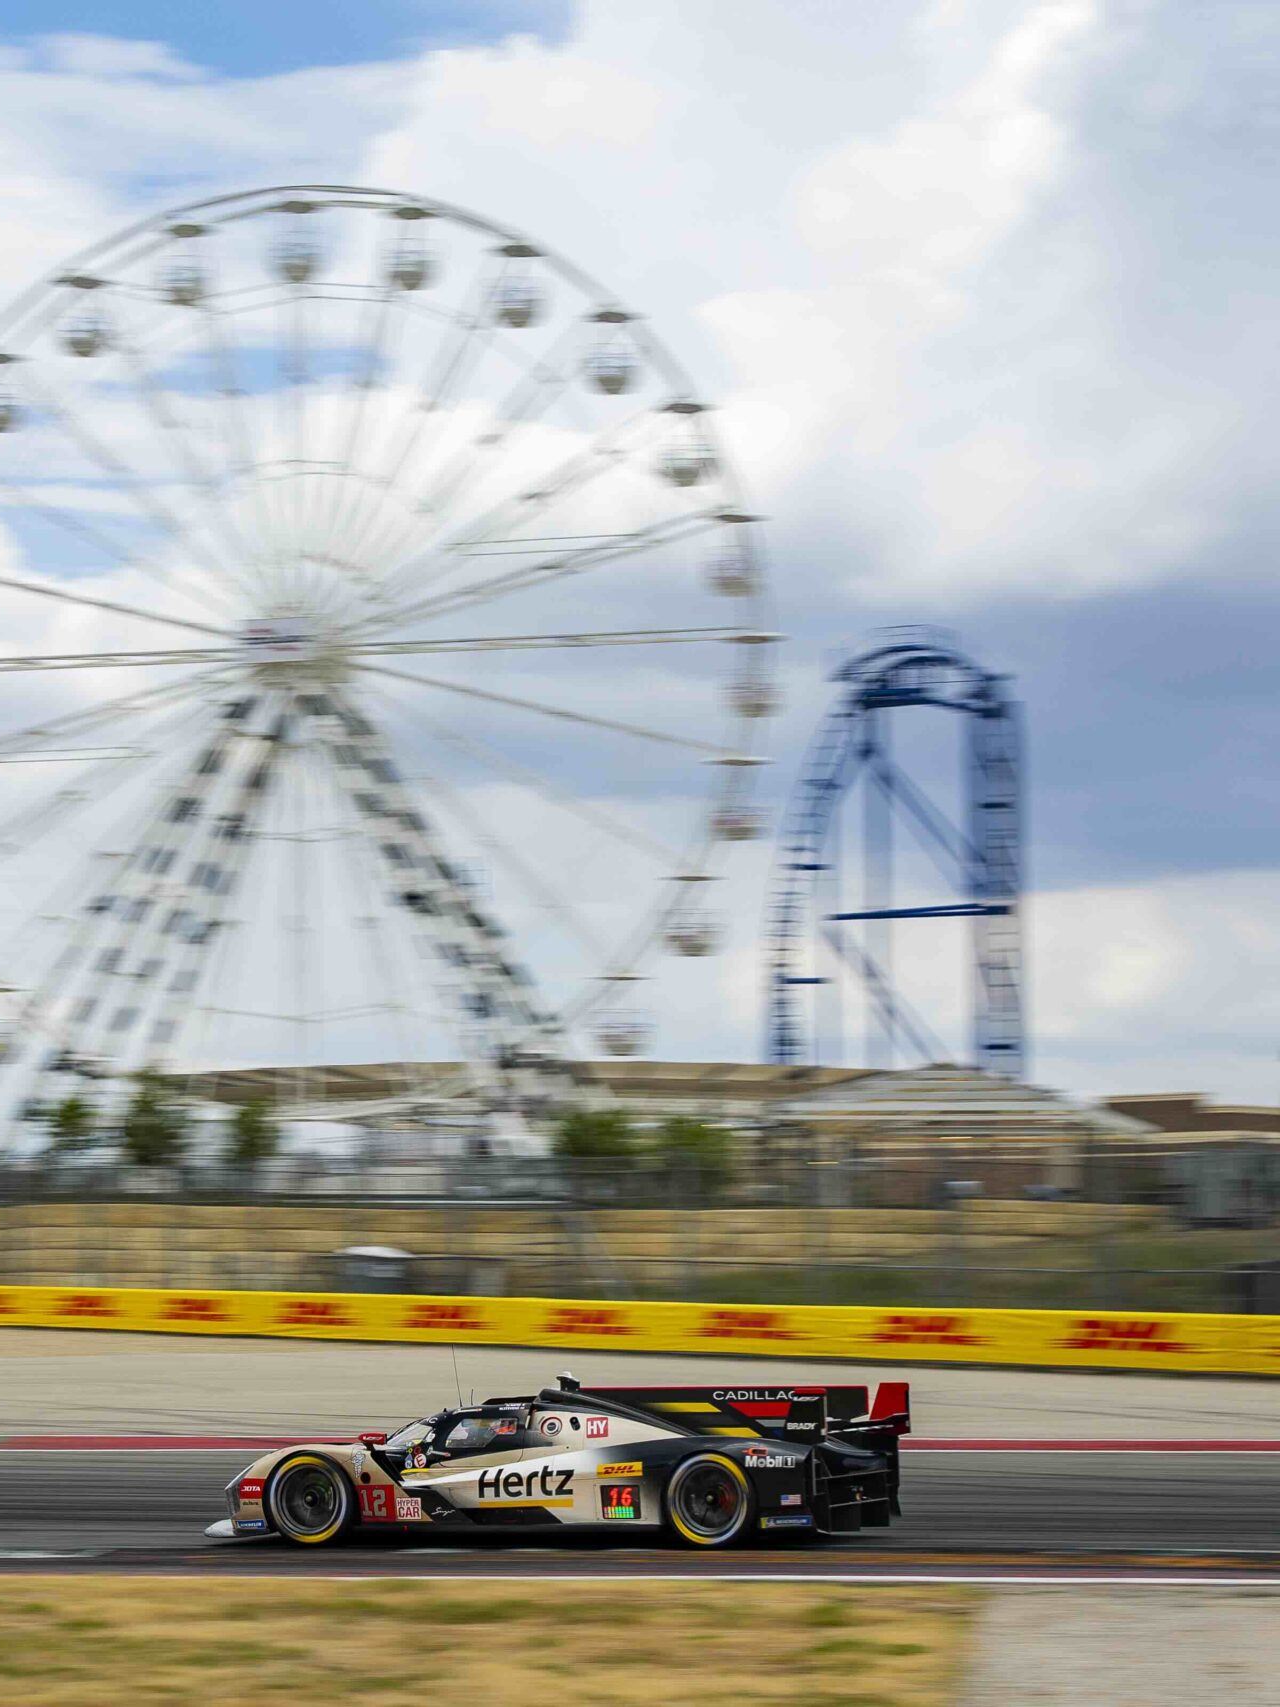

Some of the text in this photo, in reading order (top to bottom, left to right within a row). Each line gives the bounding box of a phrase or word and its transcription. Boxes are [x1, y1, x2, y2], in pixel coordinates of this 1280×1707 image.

[587, 1419, 606, 1435] HY
[787, 1422, 817, 1430] BRADY
[745, 1456, 783, 1468] Mobil
[603, 1466, 636, 1475] DHL
[478, 1465, 575, 1499] Hertz
[361, 1489, 386, 1517] 12
[610, 1487, 632, 1506] 16
[398, 1506, 420, 1518] CAR
